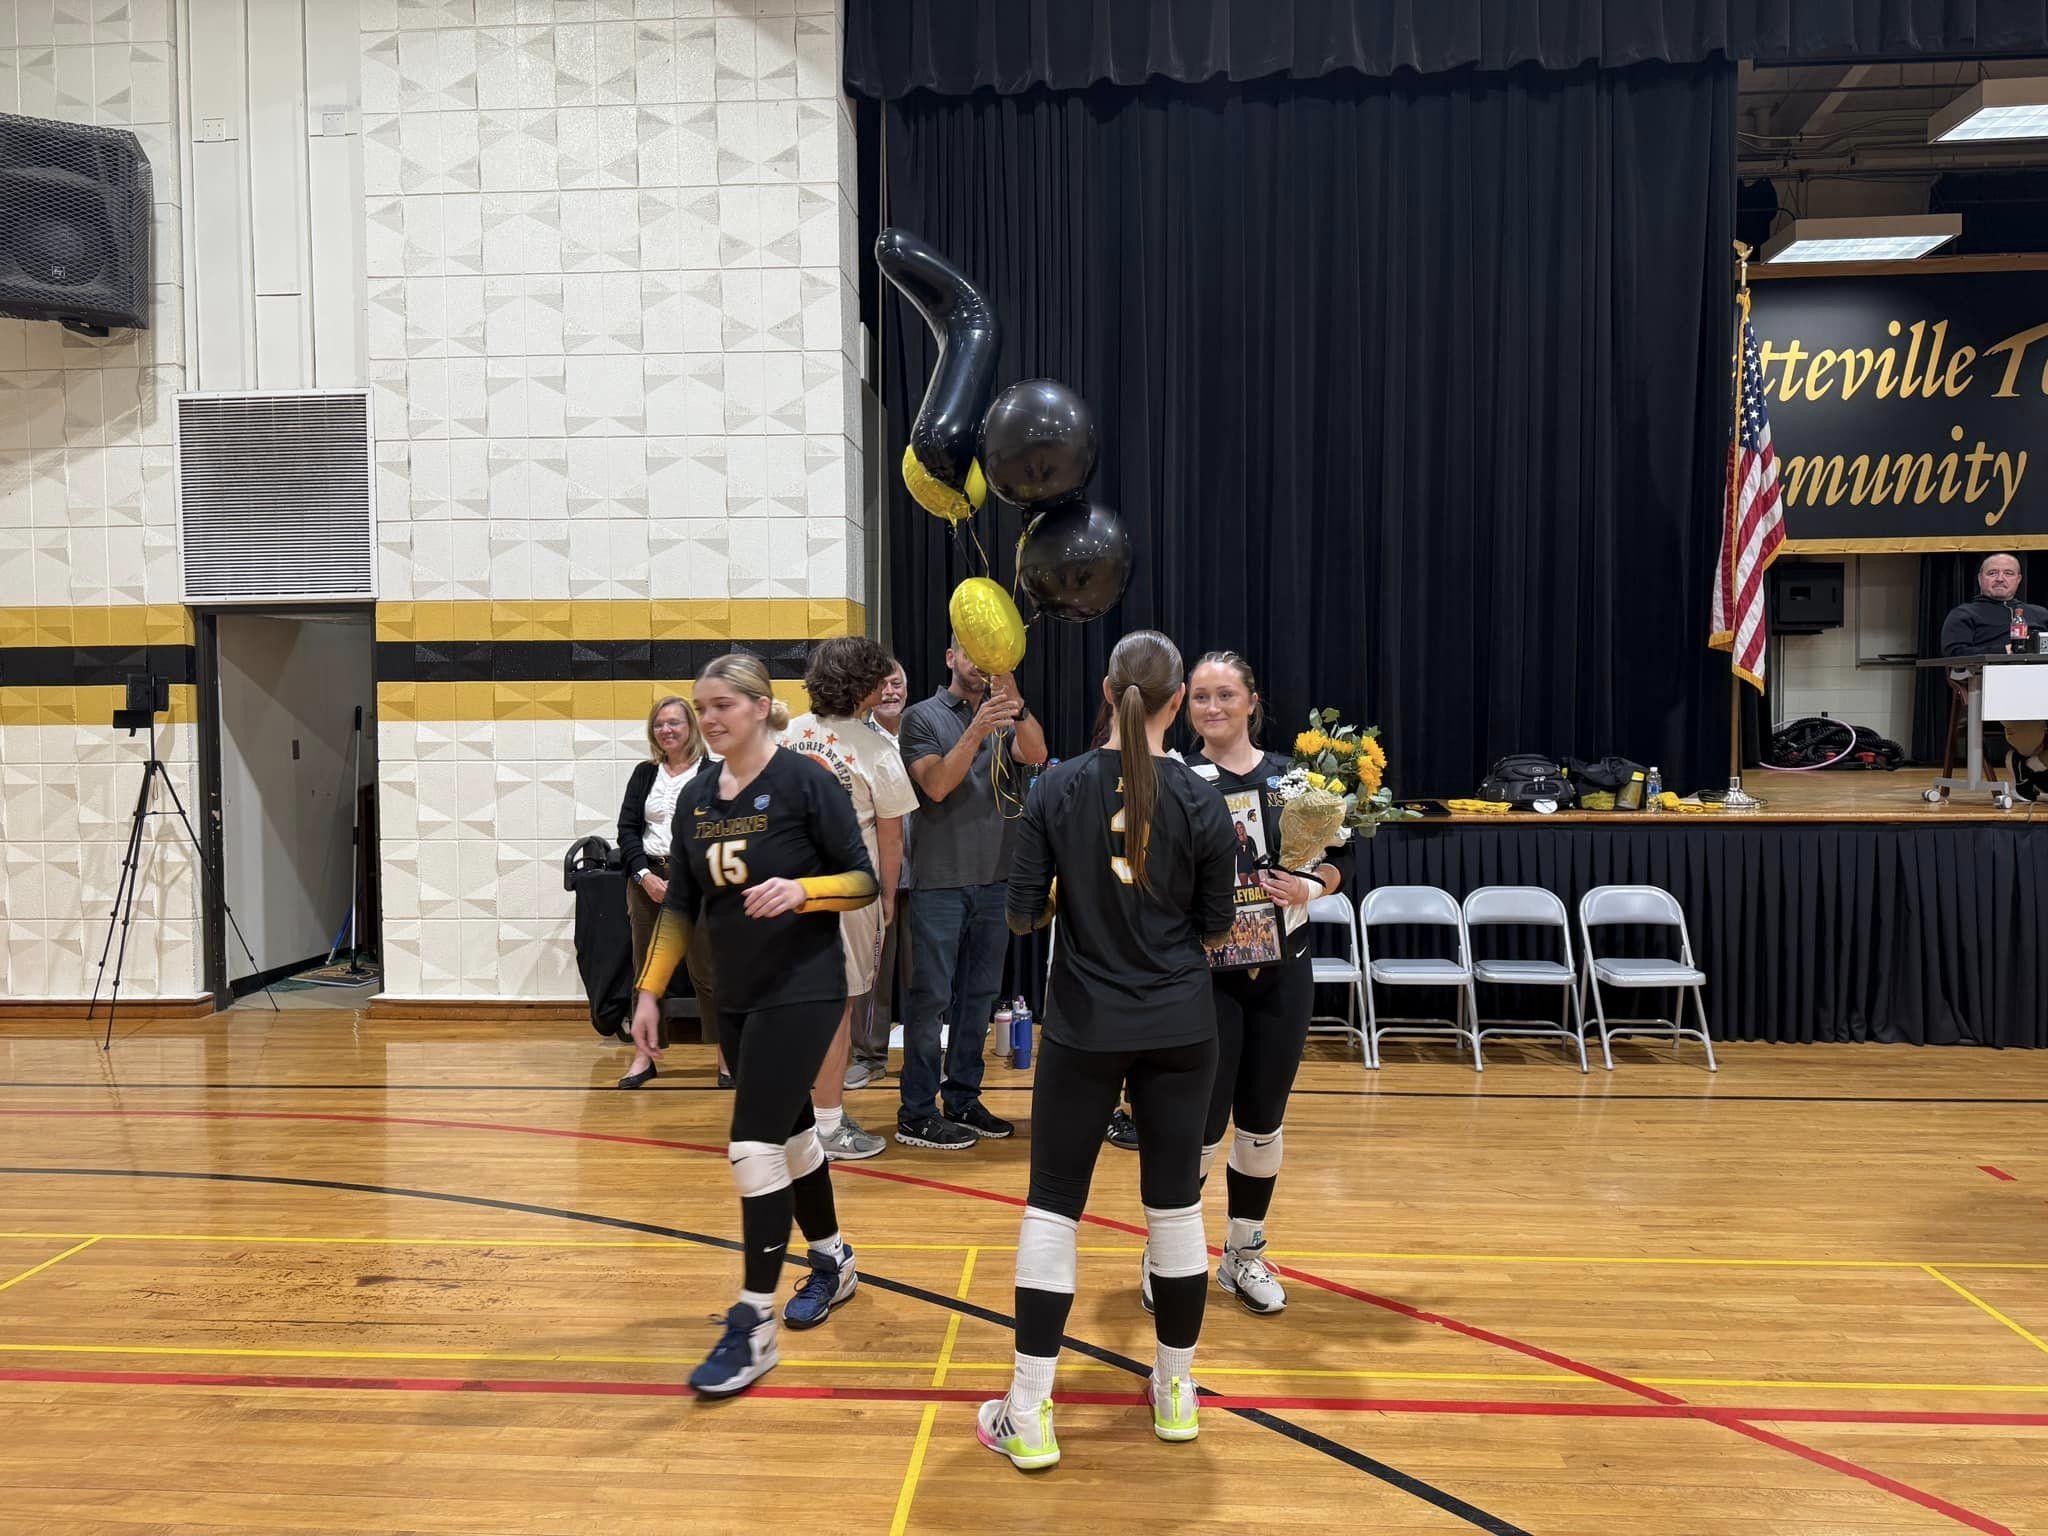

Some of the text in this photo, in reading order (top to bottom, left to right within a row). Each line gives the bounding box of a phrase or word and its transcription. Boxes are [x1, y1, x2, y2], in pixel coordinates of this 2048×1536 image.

[1758, 320, 2048, 401] tteville T
[705, 840, 748, 886] 15
[1233, 886, 1271, 904] LEYBAL
